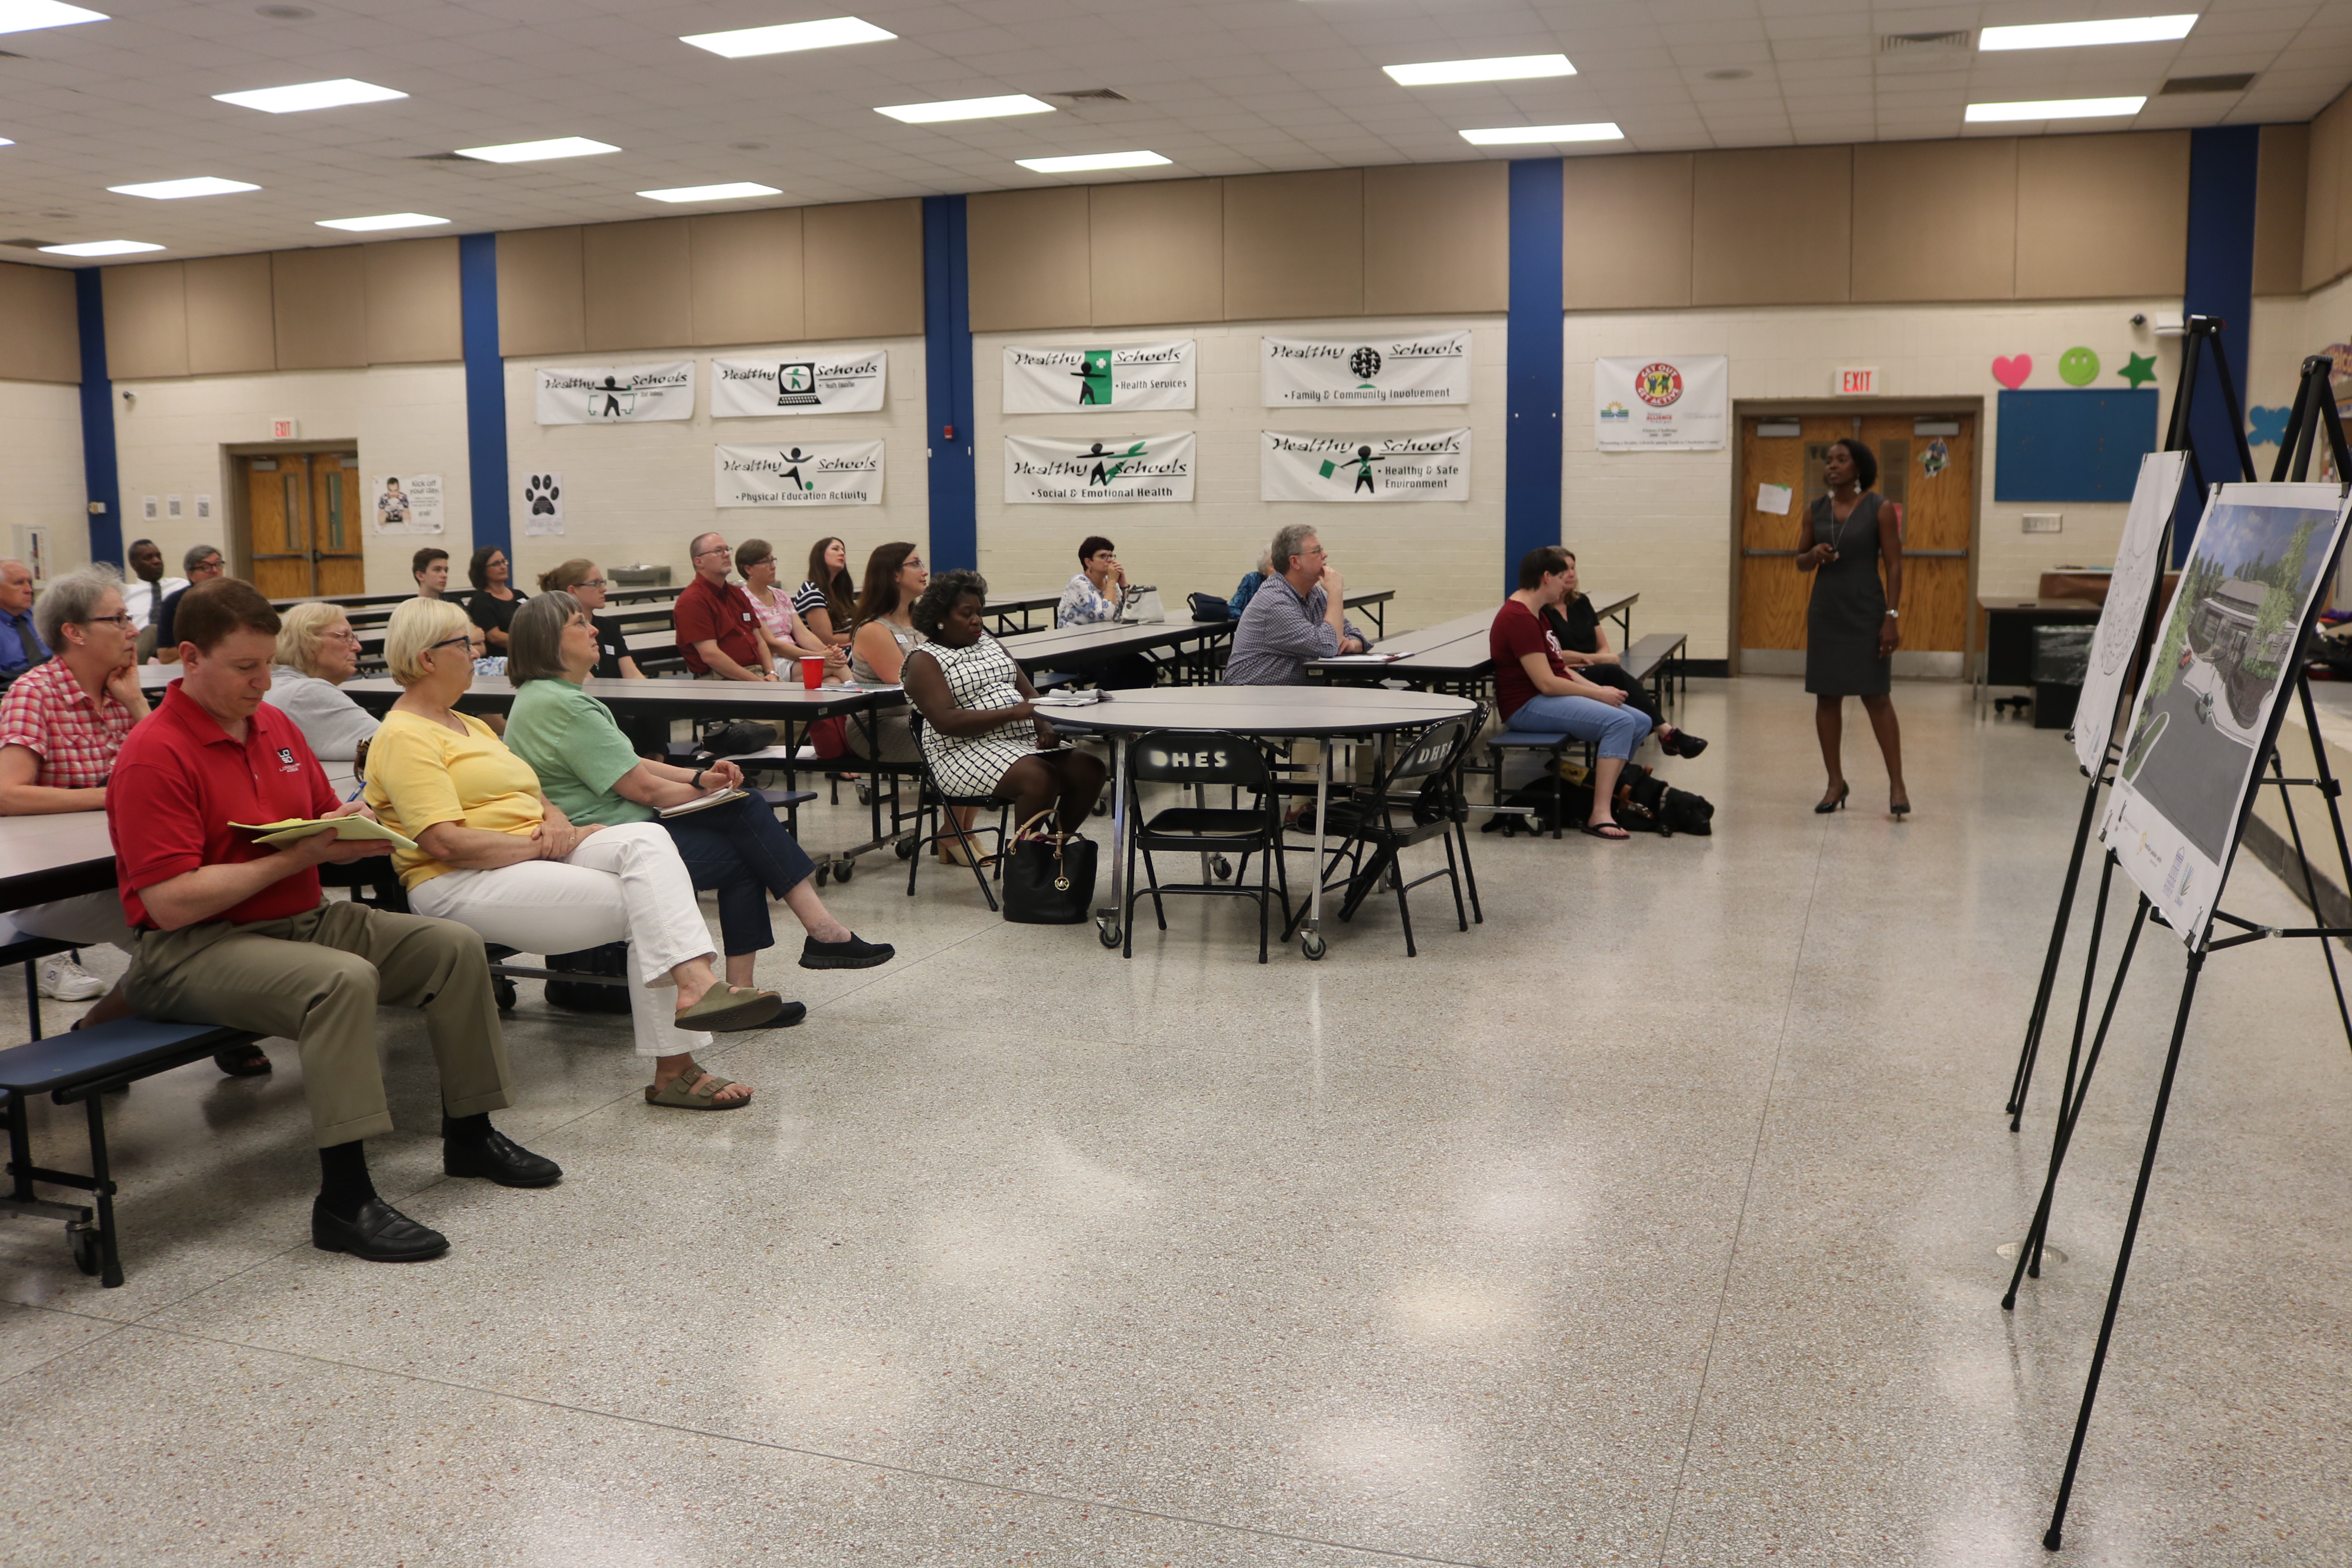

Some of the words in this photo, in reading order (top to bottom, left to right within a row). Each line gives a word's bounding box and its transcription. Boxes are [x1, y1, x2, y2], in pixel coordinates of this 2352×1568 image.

[1015, 352, 1082, 366] Healthy
[1113, 348, 1181, 362] Schools
[1271, 344, 1345, 359] Healthy
[1389, 340, 1463, 355] Schools
[722, 368, 776, 381] Healthy
[815, 362, 877, 376] Schools
[1641, 365, 1657, 378] GET
[1658, 364, 1678, 377] OUT
[545, 378, 595, 389] Healthy
[631, 372, 687, 386] Schools
[1121, 380, 1148, 390] Health
[1150, 378, 1187, 388] Services
[1843, 371, 1872, 393] EXIT
[1291, 390, 1321, 402] Family
[1324, 390, 1330, 399] &
[1334, 389, 1387, 400] Community
[1390, 387, 1451, 398] Involvement
[1638, 387, 1652, 400] GET
[1650, 388, 1680, 404] ACTIVE
[275, 421, 291, 437] EXIT
[1272, 437, 1354, 453] Healthy
[1379, 436, 1461, 452] Schools
[723, 459, 782, 472] Healthy
[816, 456, 877, 470] Schools
[1014, 460, 1088, 476] Healthy
[1115, 458, 1187, 474] Schools
[1385, 466, 1423, 477] Healthy
[1426, 465, 1433, 474] &
[1437, 465, 1459, 475] Safe
[1385, 479, 1448, 489] Environment
[741, 492, 778, 502] Physical
[782, 491, 827, 501] Education
[829, 490, 867, 501] Activity
[1037, 488, 1067, 498] Social
[1070, 489, 1077, 498] &
[1082, 488, 1134, 498] Emotional
[1138, 487, 1173, 496] Health
[1150, 750, 1229, 767] DHES
